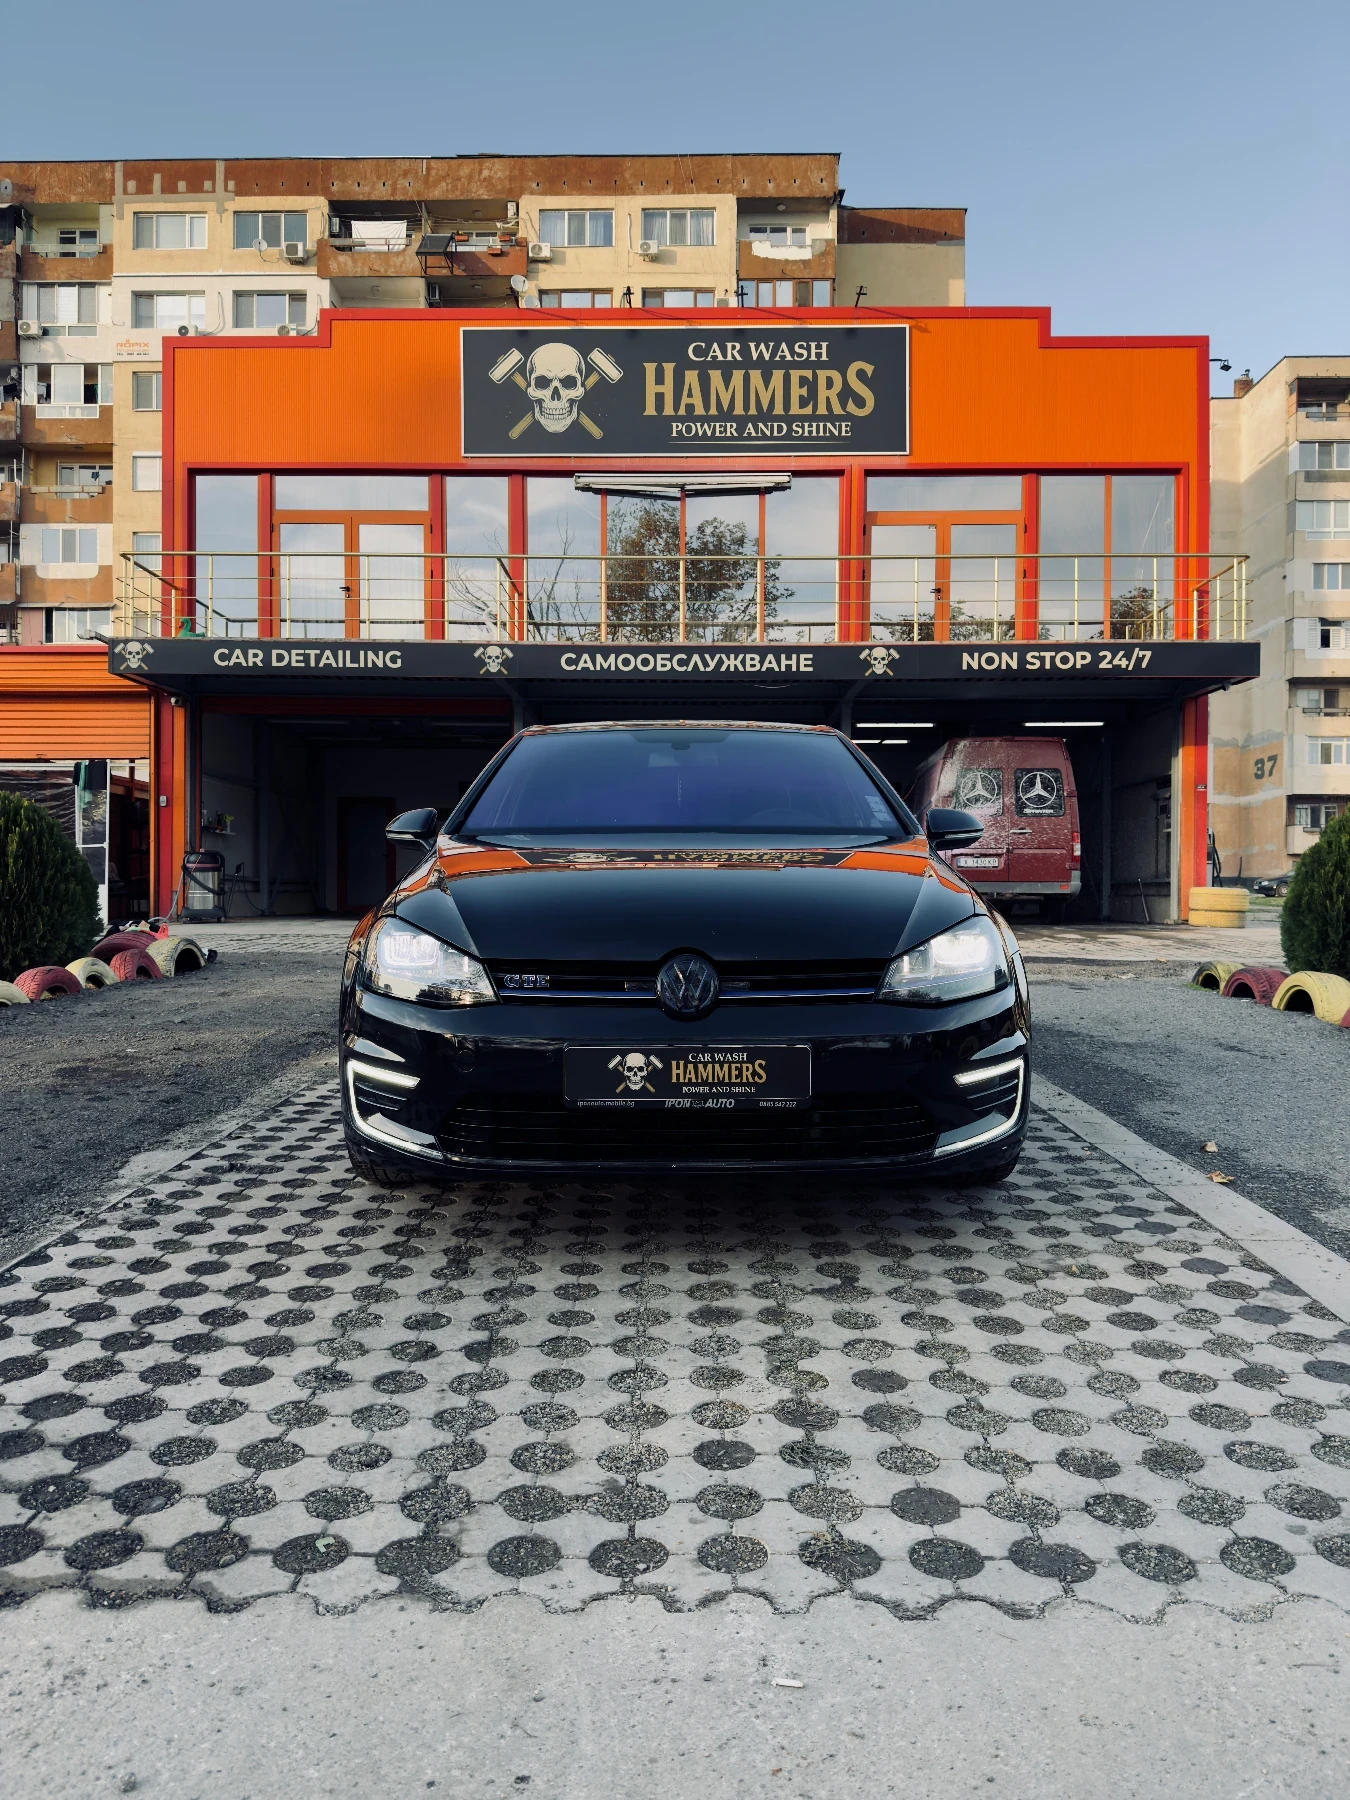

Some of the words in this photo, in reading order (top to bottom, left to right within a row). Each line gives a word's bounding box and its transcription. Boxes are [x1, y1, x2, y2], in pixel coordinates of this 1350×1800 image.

[687, 342, 742, 361] CAR
[747, 342, 829, 361] WASH
[643, 361, 875, 417] HAMMERS
[670, 422, 739, 437] POWER
[742, 422, 788, 437] AND
[791, 422, 852, 437] SHINE
[213, 648, 264, 668] CAR
[271, 649, 403, 669] DETAILING
[560, 652, 814, 672] САМООБСЛУЖВАНЕ
[962, 651, 1018, 671] NON
[1026, 650, 1092, 670] STOP
[1098, 649, 1152, 671] 24/7
[1254, 754, 1278, 780] 37
[503, 974, 550, 988] GTE
[688, 1052, 712, 1062] CAR
[714, 1052, 748, 1061] WASH
[671, 1059, 767, 1084] HAMMERS
[664, 1098, 692, 1108] IPON
[704, 1098, 736, 1108] AUTO
